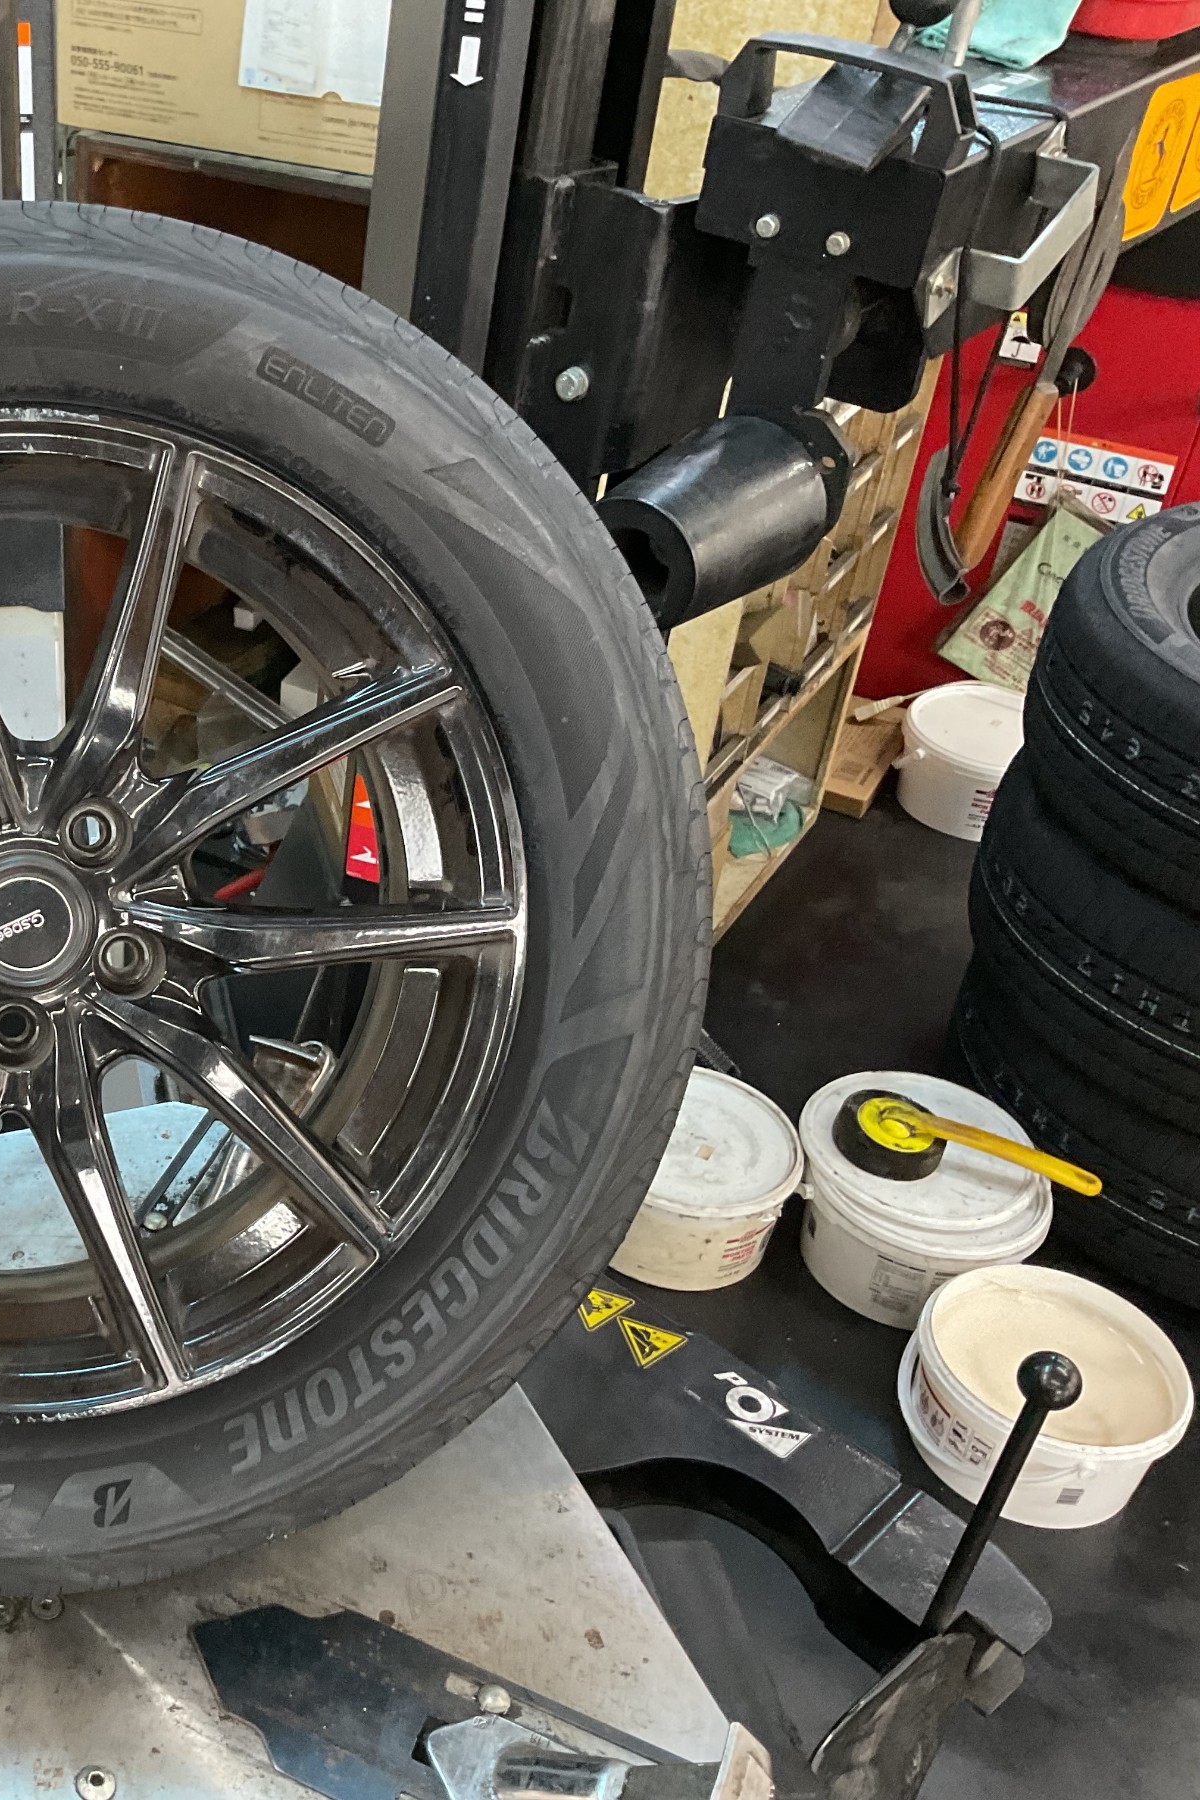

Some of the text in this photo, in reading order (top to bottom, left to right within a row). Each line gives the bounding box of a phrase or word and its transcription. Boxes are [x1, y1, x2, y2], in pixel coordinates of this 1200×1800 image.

[70, 55, 144, 76] 050-555-90061
[223, 1096, 592, 1474] BRIDGESTONE
[749, 1426, 800, 1441] SYSTEM
